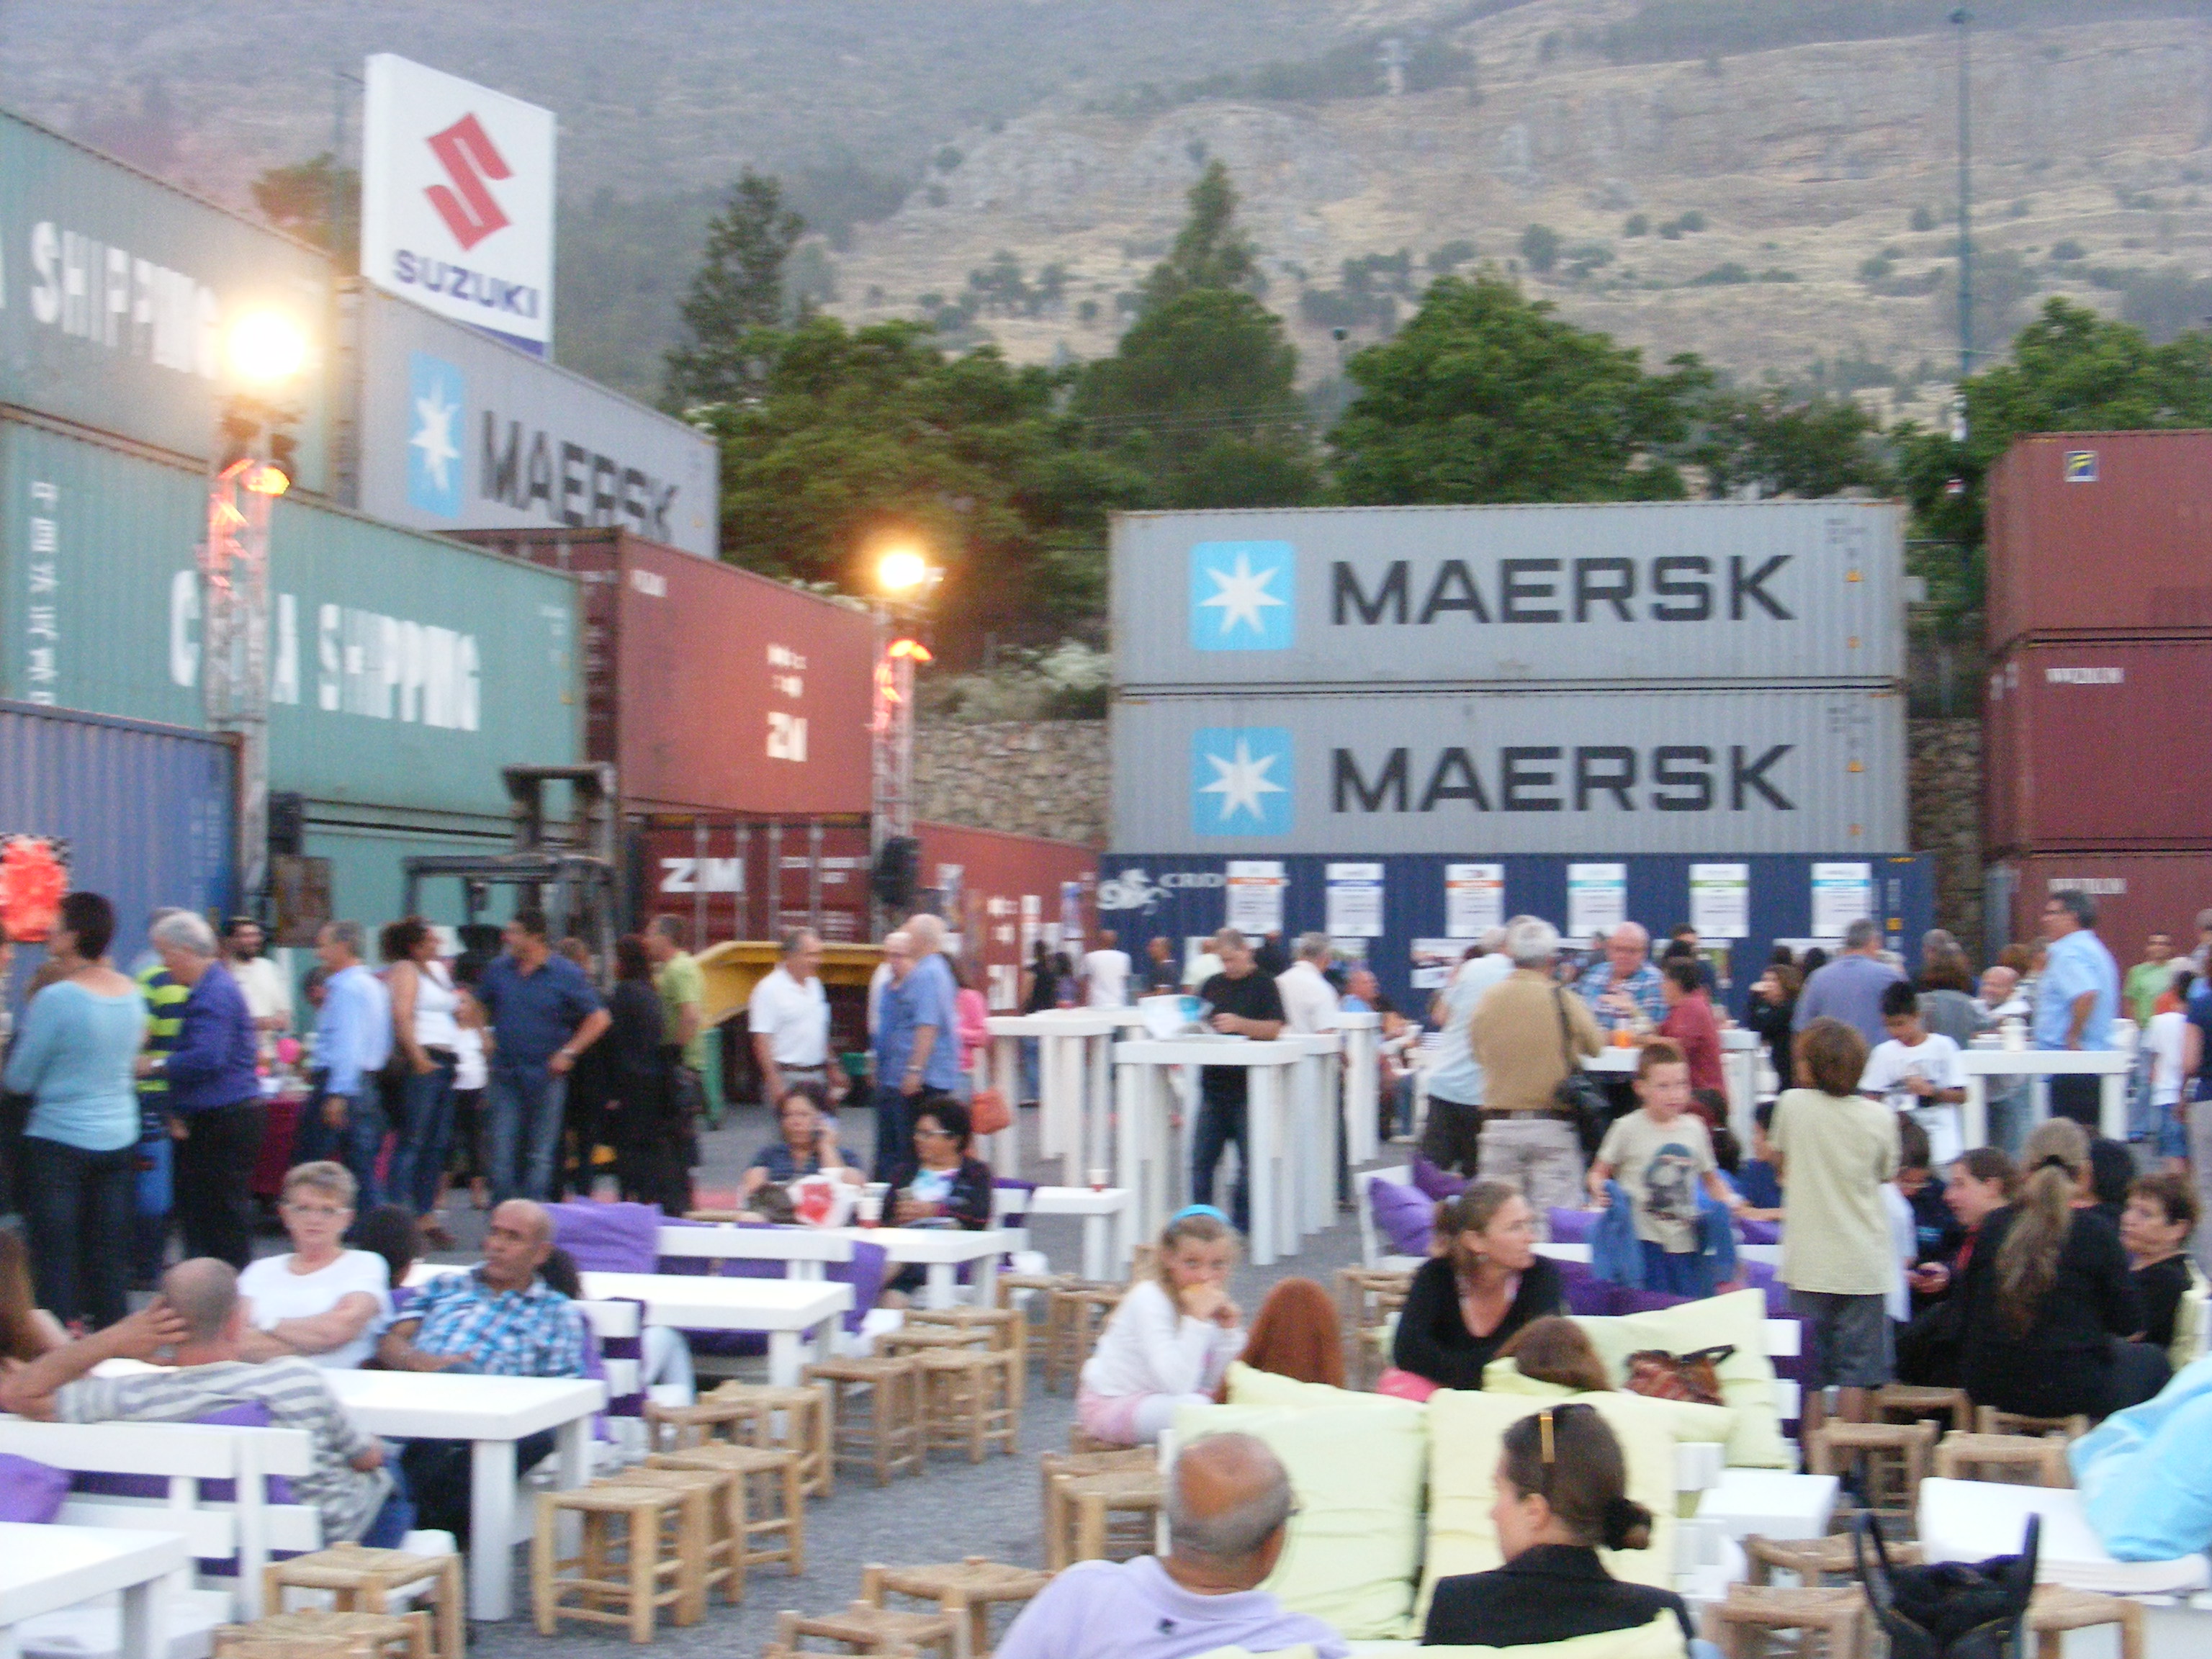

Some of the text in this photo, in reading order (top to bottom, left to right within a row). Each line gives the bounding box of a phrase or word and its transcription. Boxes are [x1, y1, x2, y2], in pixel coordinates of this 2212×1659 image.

[394, 249, 539, 319] SUZUKI
[480, 410, 680, 543] MAERSK
[1332, 554, 1798, 626] MAERSK
[1332, 744, 1799, 813] MAERSK
